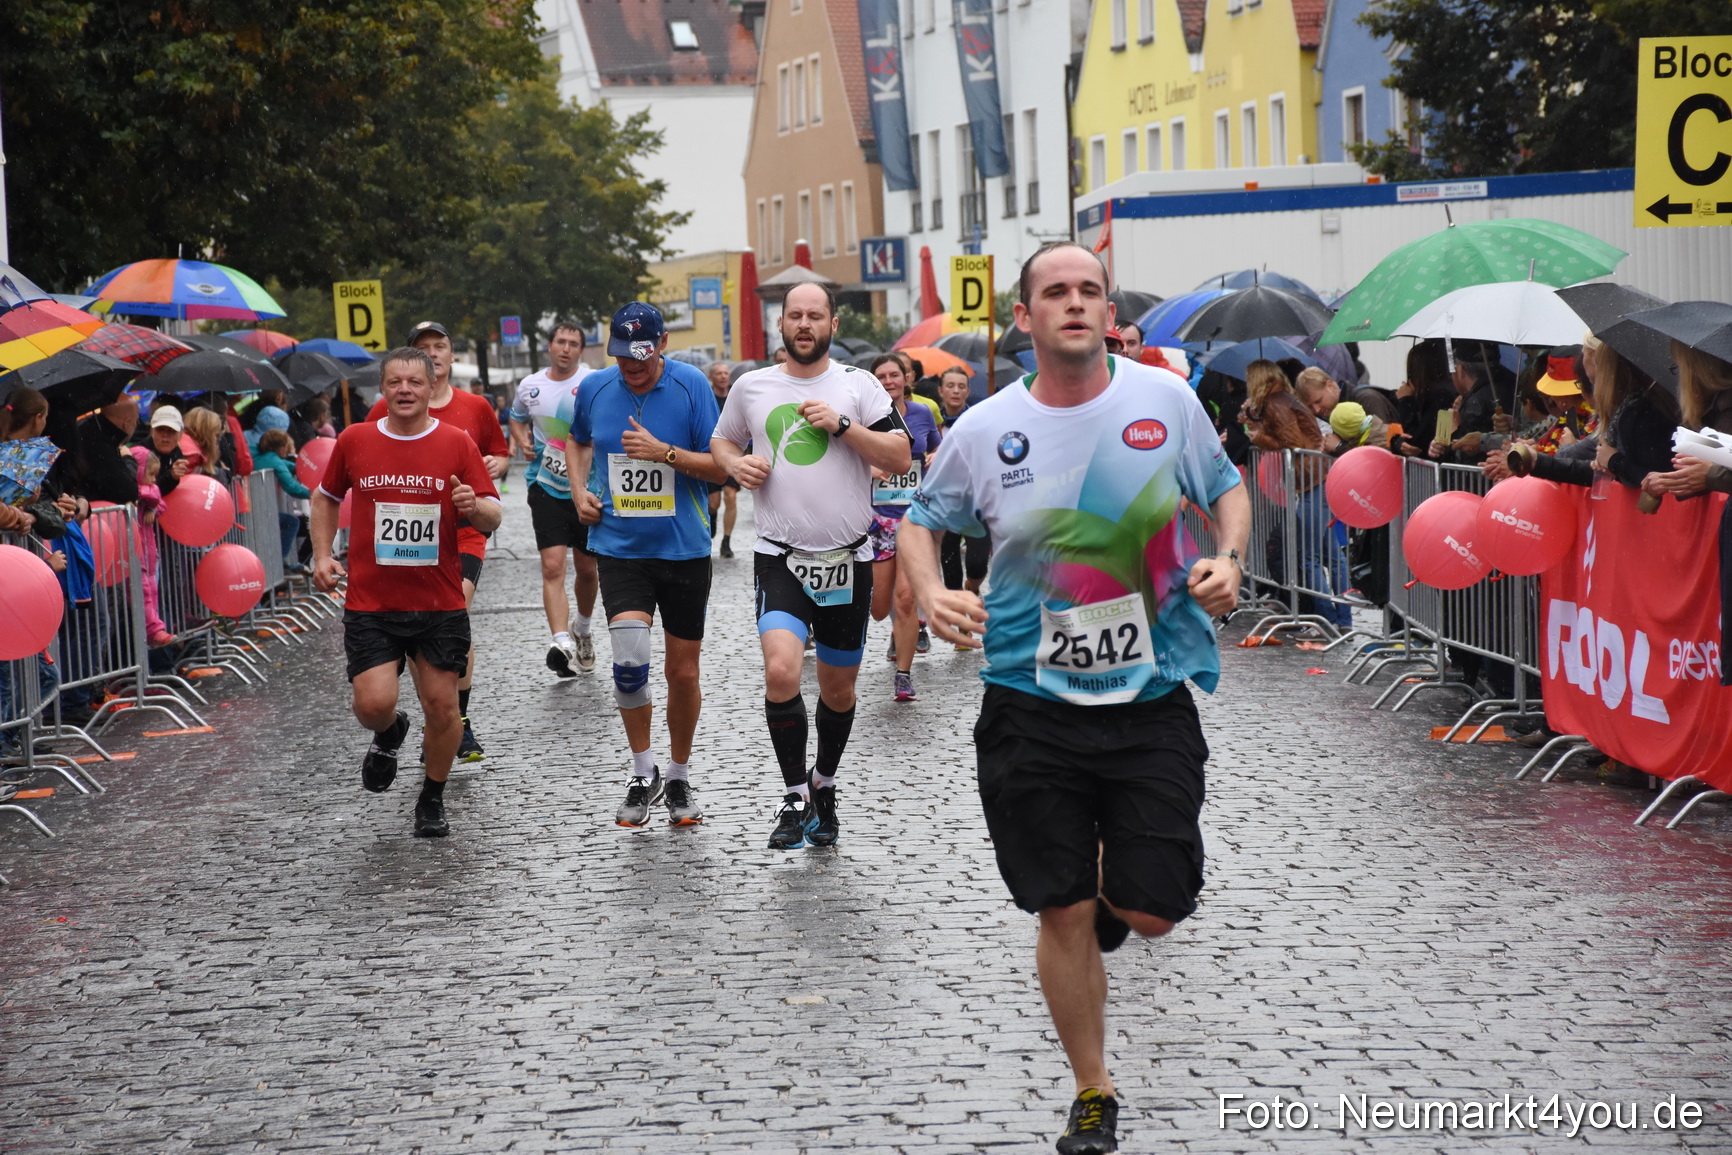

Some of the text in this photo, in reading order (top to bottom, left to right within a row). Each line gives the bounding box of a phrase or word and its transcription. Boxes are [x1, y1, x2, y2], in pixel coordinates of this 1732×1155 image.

[960, 1, 994, 82] K&L
[866, 23, 901, 102] K&L
[1129, 82, 1158, 116] HOTEL
[1667, 93, 1732, 187] C
[956, 259, 989, 271] Block
[340, 284, 376, 298] Block
[962, 277, 983, 311] D
[348, 303, 372, 337] D
[1129, 427, 1163, 442] Hervis
[360, 474, 433, 489] NEUMARKT
[621, 469, 663, 493] 320
[1001, 467, 1034, 483] PARTL
[1002, 477, 1034, 490] Neumarkt
[405, 506, 435, 515] BOCK
[621, 498, 663, 510] Wolfgang
[381, 518, 434, 543] 2604
[1491, 508, 1544, 536] RÖDL
[394, 548, 419, 558] Anton
[794, 563, 848, 590] 2570
[1078, 600, 1134, 622] BOCK
[1049, 622, 1142, 669] 2542
[1067, 675, 1128, 691] Mathias
